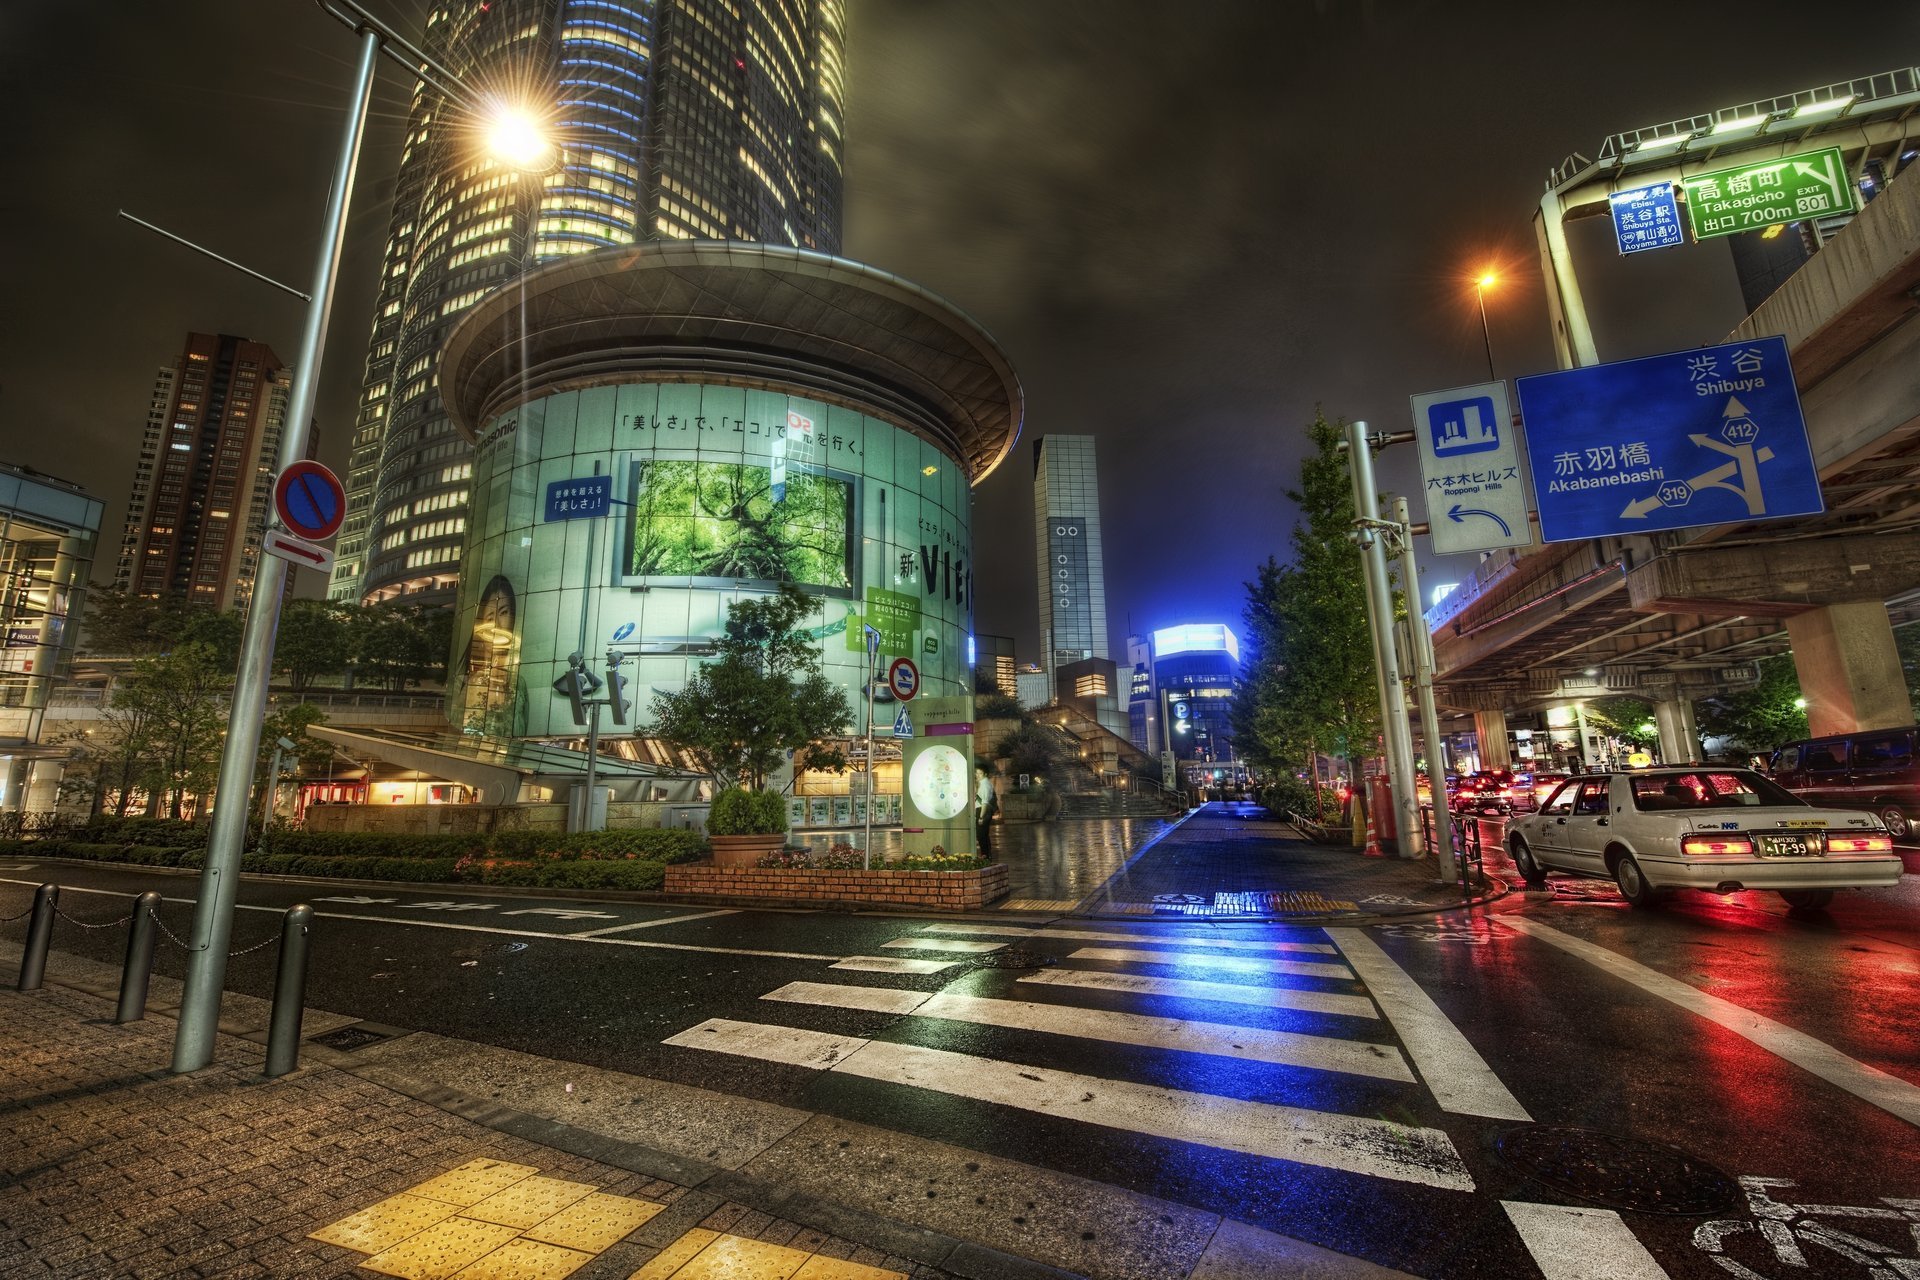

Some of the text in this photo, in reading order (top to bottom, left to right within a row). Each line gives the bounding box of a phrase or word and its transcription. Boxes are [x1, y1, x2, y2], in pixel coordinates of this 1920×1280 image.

[1698, 171, 1781, 202] 高樹町
[1796, 185, 1820, 196] EXIT
[1631, 200, 1655, 210] Ebisu
[1700, 190, 1785, 214] Takagicho
[1799, 196, 1828, 212] 301
[1621, 205, 1670, 225] 渋谷駅
[1622, 216, 1672, 231] Shibuya Sta.
[1704, 206, 1792, 232] 出口 700m
[1636, 224, 1677, 241] 青山通り
[1625, 235, 1678, 251] Aoyama dori
[1687, 347, 1764, 382] 渋谷
[1696, 376, 1765, 397] Shibuya
[474, 419, 517, 459] nasonic
[1727, 423, 1754, 440] 412
[1553, 441, 1652, 477] 赤羽橋
[1428, 467, 1518, 490] 六本木ヒルズ
[1548, 466, 1664, 494] Akabanebashi
[1444, 482, 1502, 496] Roppongi Hills
[1662, 486, 1688, 501] 319
[1774, 843, 1807, 854] 17-99
